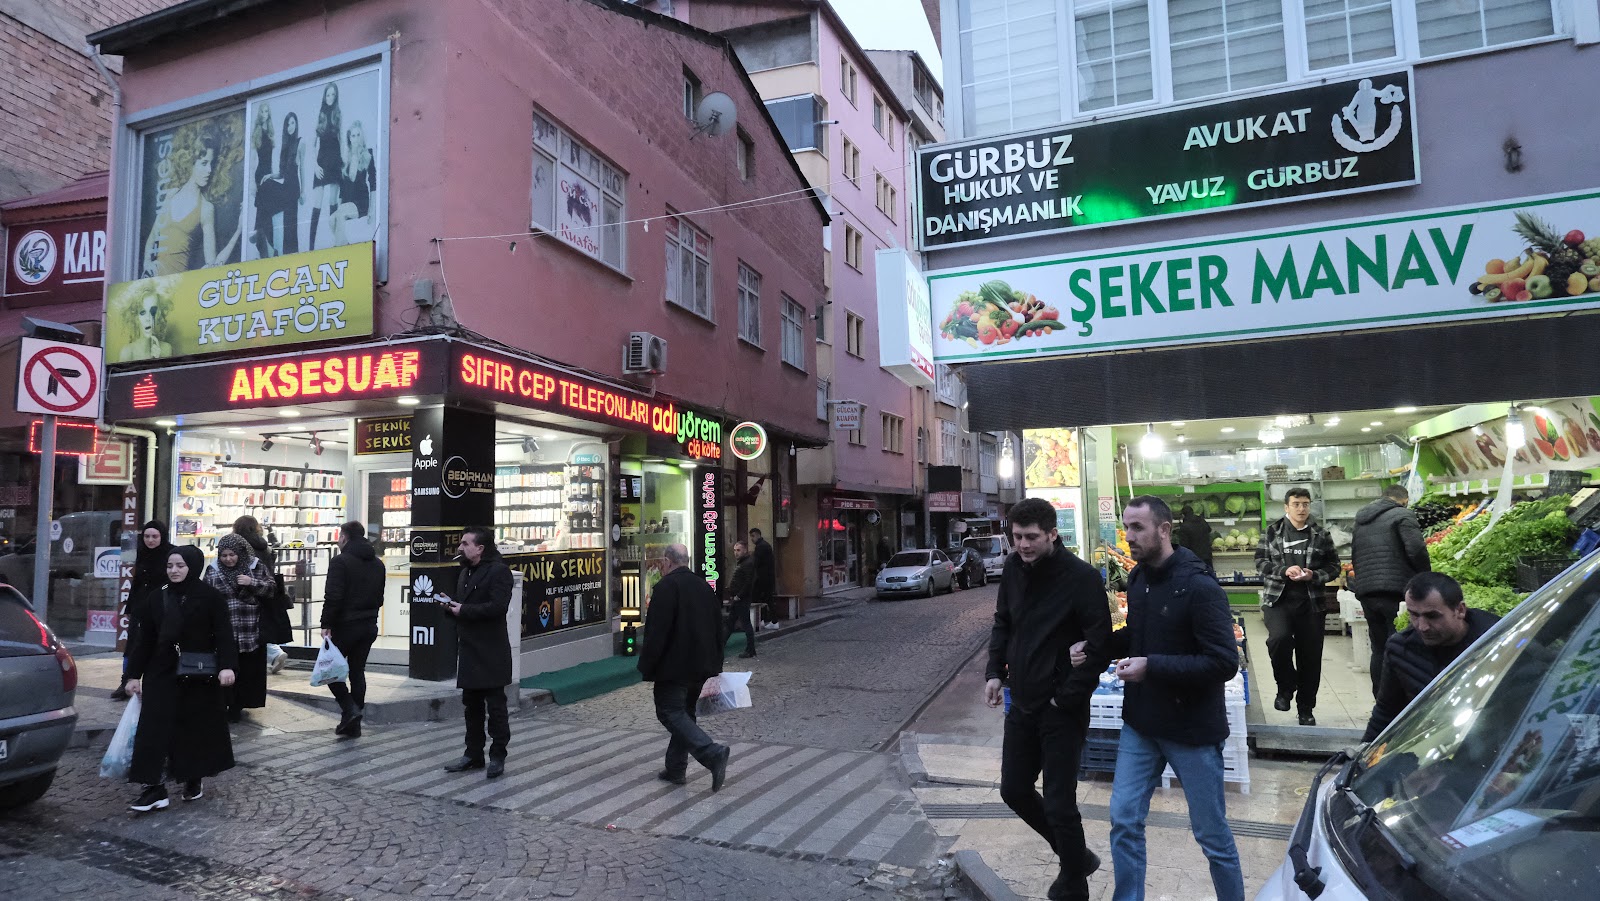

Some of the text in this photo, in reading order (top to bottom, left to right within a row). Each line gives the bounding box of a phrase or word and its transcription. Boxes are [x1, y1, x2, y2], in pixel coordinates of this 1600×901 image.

[1183, 108, 1312, 151] AVUKAT
[929, 134, 1075, 183] GÜRBÜZ
[943, 169, 1059, 205] HUKUK VE
[1146, 156, 1359, 206] YAVUZ GÜRBÜZ
[926, 195, 1084, 237] DANIŞMANLIK
[561, 223, 598, 254] Kuaför
[198, 260, 349, 309] GÜLCAN
[1068, 223, 1475, 337] ŞEKER MANAV
[198, 296, 347, 345] KUAFÖR
[461, 354, 649, 424] SIFIR CEP TELEFONLARI
[367, 419, 411, 432] TEKNİK
[652, 403, 721, 443] adıyörem
[836, 406, 858, 414] GÜLCAN
[365, 433, 411, 449] SERVİS
[414, 457, 438, 470] Apple
[448, 469, 493, 482] BEDİRHAN
[414, 487, 440, 496] SAMSUNG
[561, 552, 603, 578] SERVİS
[91, 614, 114, 629] SGK
